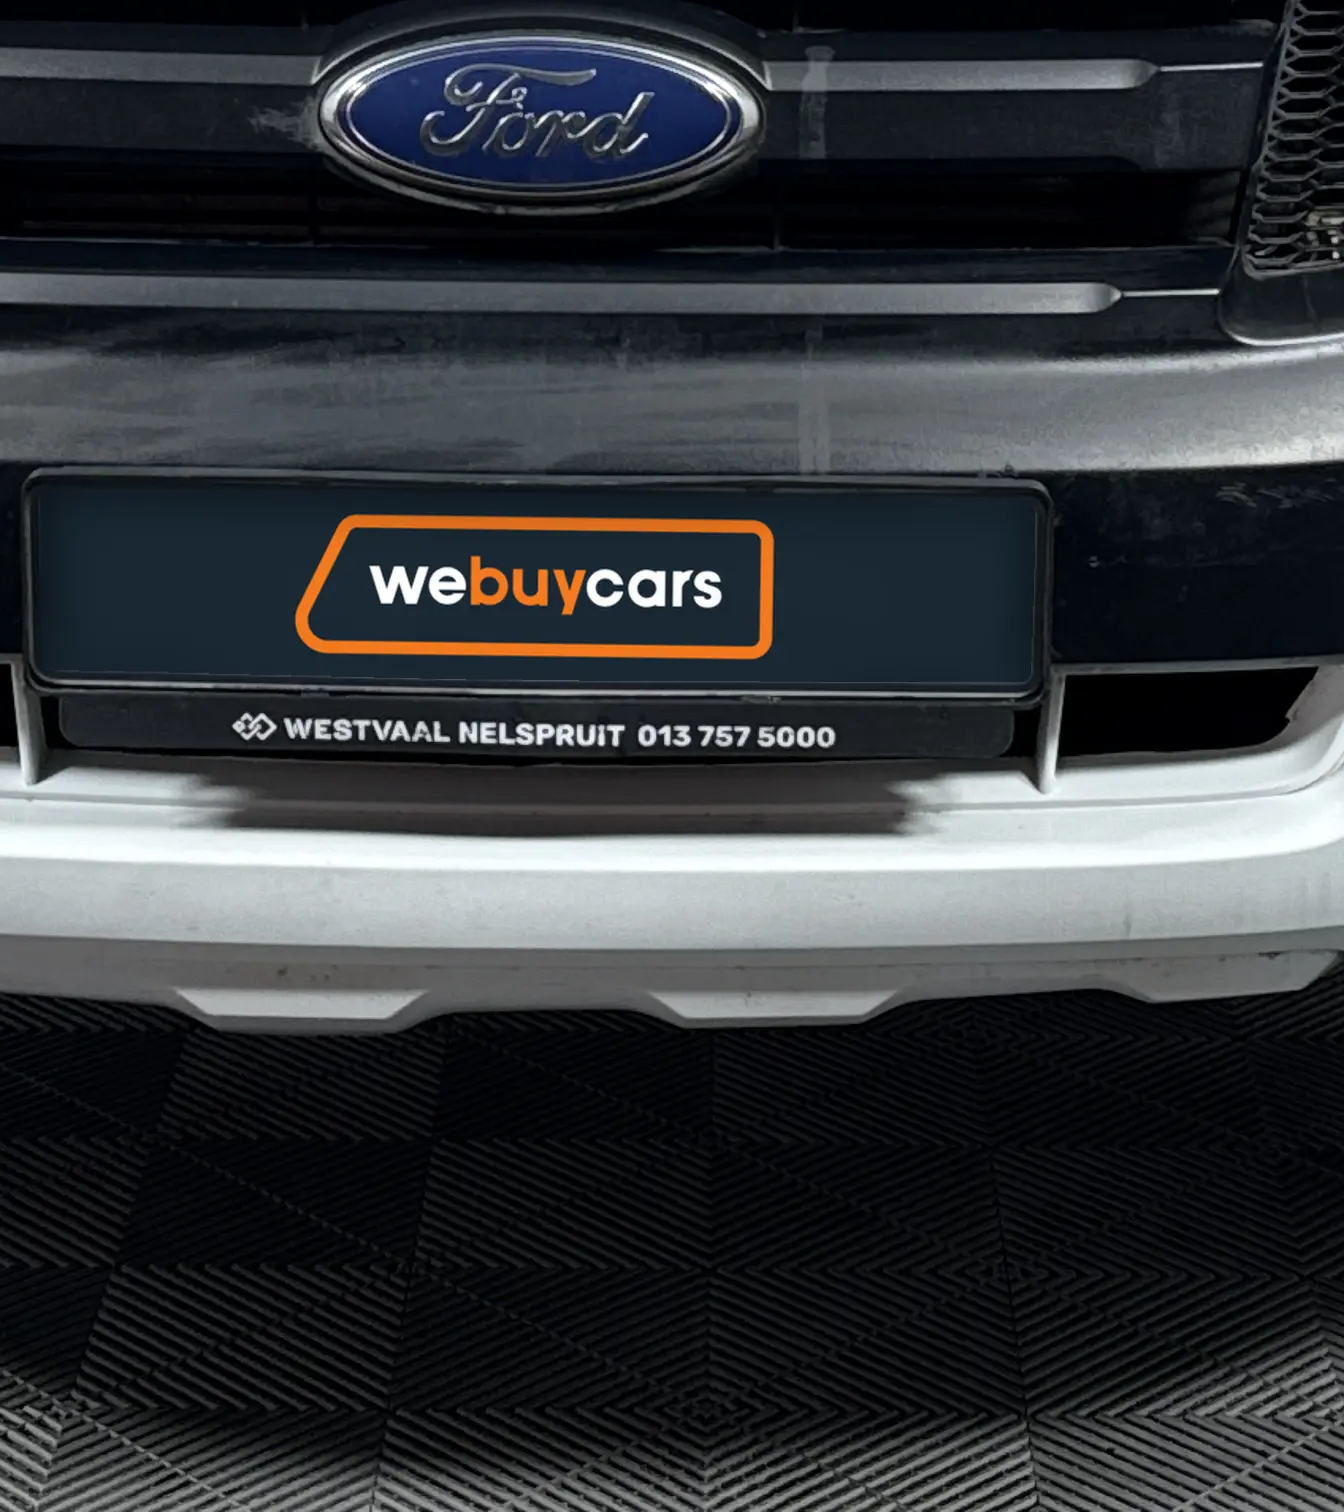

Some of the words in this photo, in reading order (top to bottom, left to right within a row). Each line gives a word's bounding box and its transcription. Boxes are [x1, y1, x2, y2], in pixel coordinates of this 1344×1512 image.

[420, 62, 656, 160] Ford
[283, 717, 451, 743] WESTVAAL
[458, 721, 626, 747] NELSPRUIT
[637, 724, 692, 748] 013
[697, 725, 752, 748] 757
[757, 725, 836, 748] 5000
